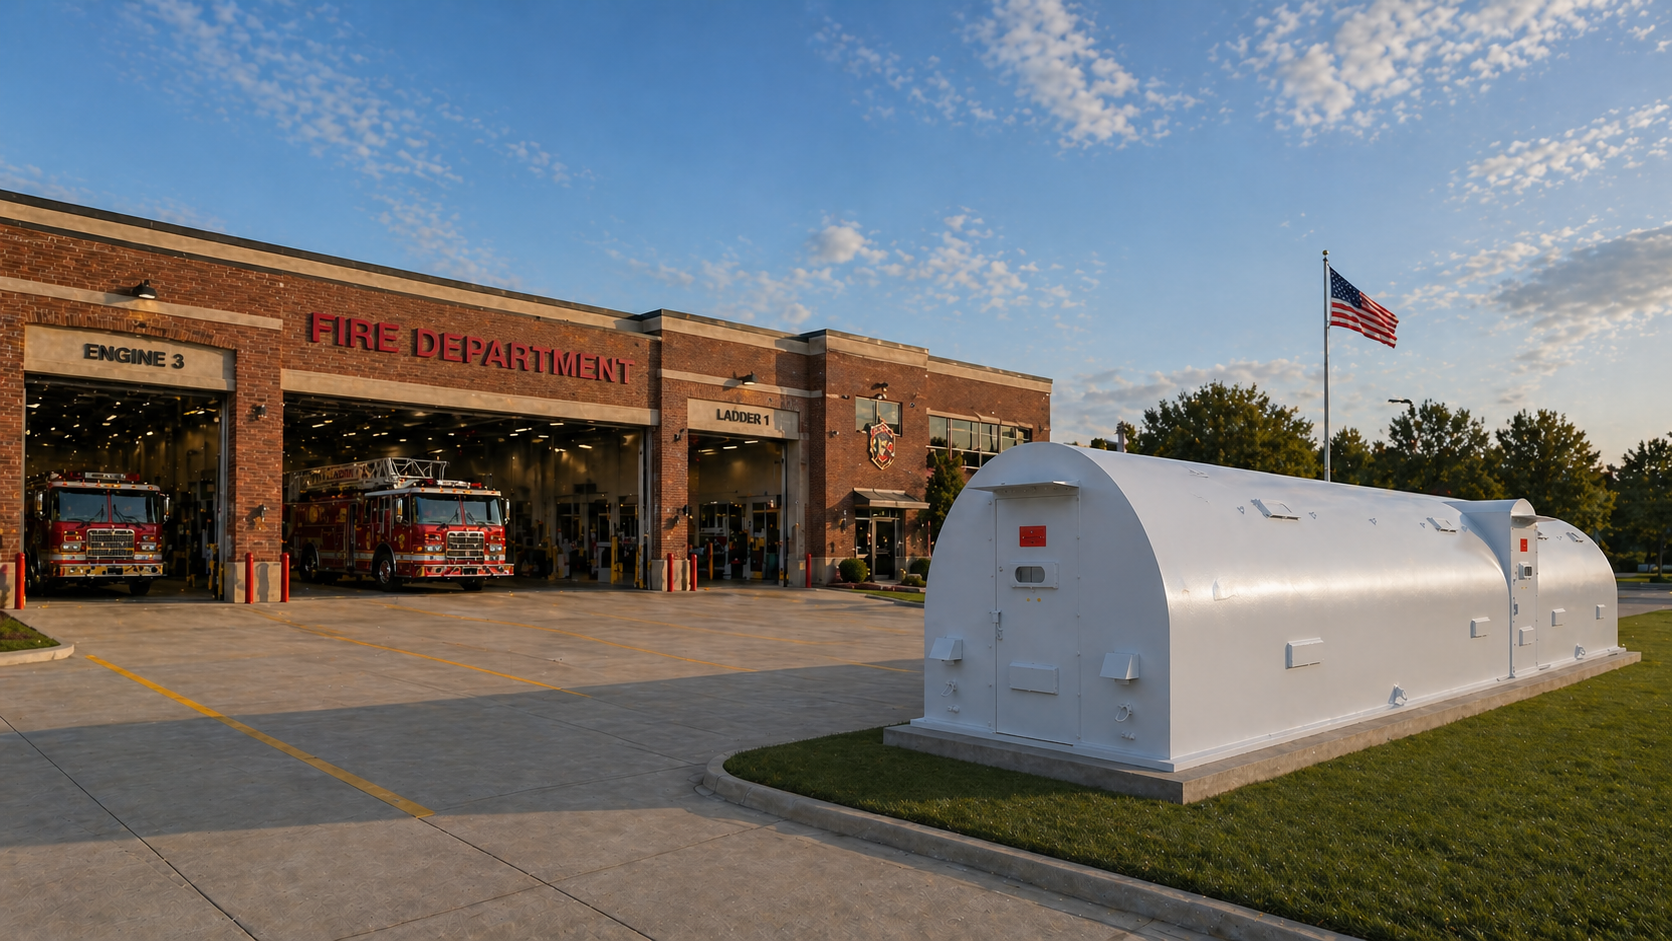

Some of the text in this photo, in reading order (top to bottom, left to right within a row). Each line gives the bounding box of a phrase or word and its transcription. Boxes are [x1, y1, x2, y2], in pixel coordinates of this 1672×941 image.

[83, 343, 185, 369] ENGINE 3
[311, 312, 636, 384] FIRE DEPARTMENT
[716, 408, 769, 426] LADDER 1
